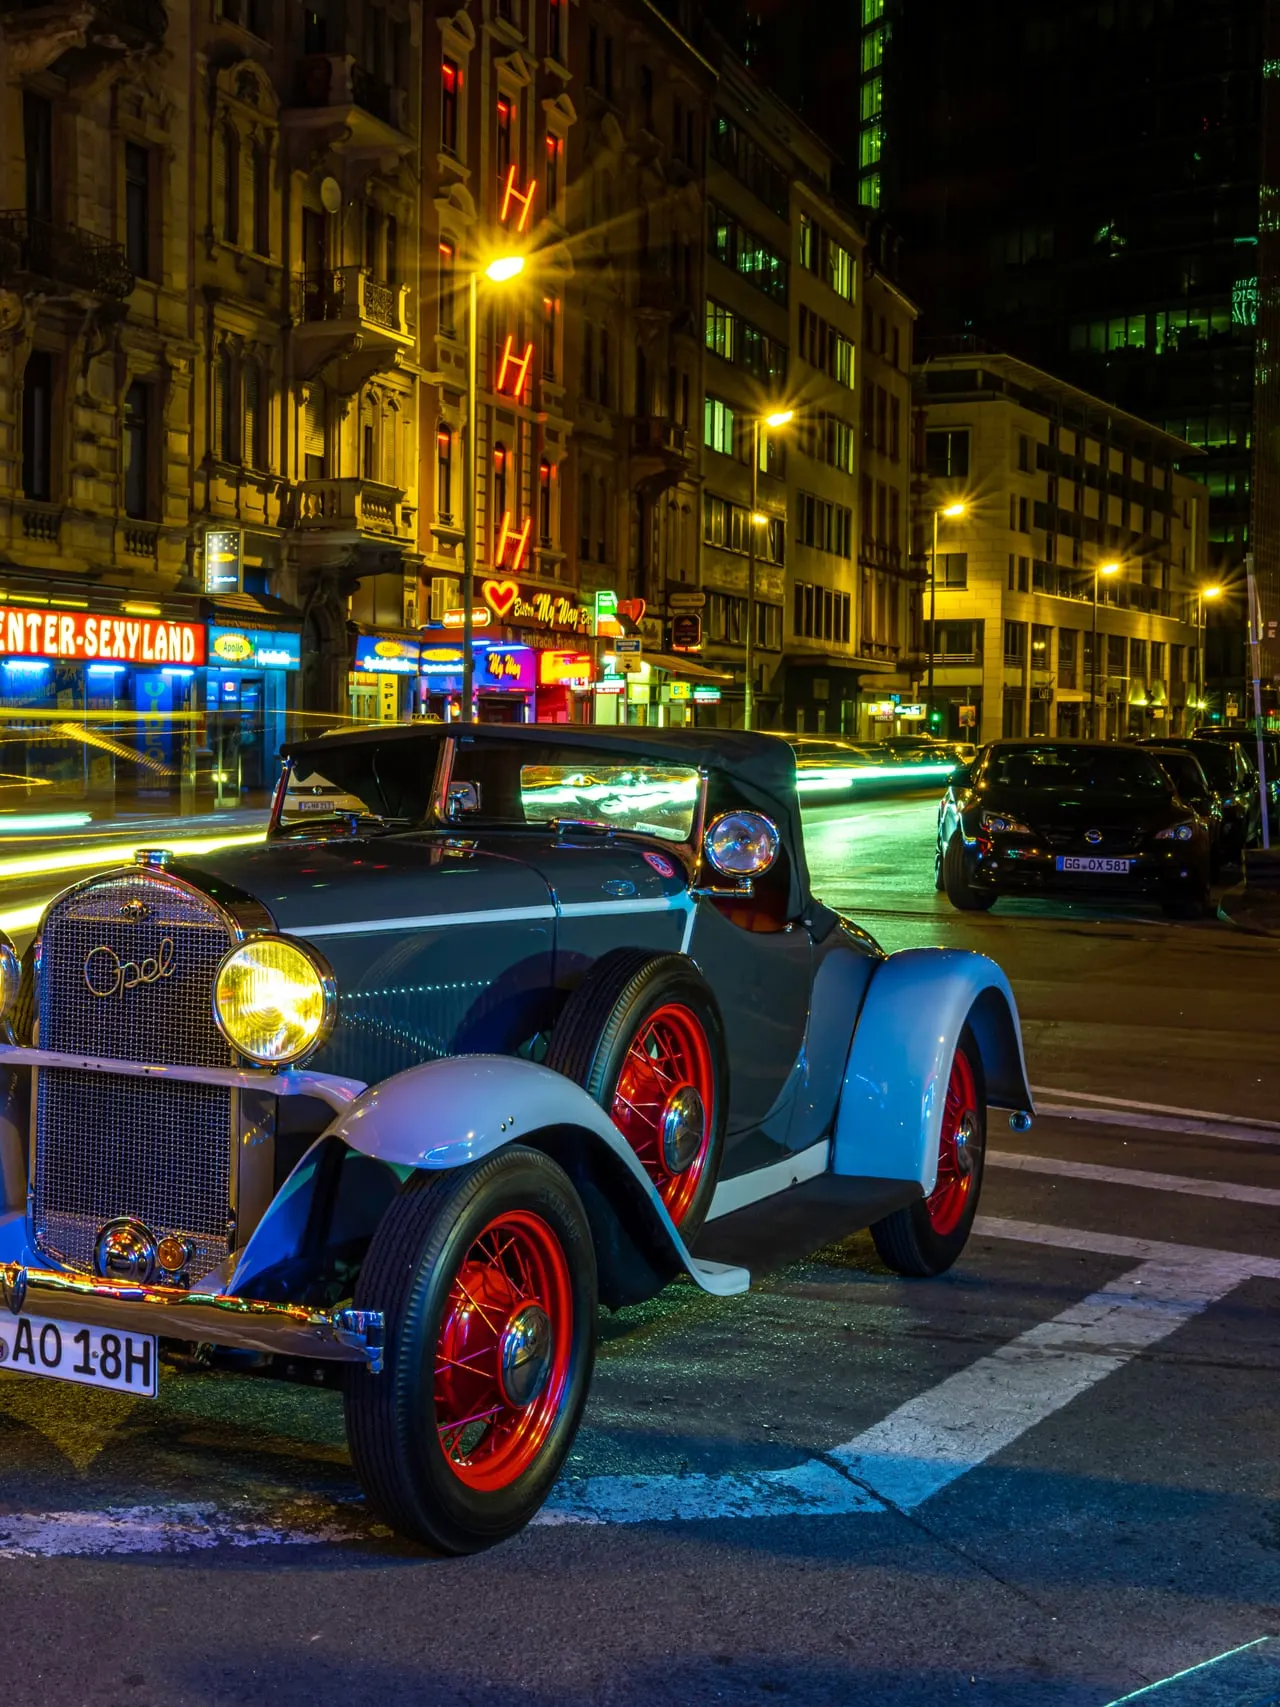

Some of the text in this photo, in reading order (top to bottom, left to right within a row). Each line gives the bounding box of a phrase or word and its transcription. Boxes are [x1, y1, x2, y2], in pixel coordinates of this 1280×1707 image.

[500, 165, 536, 232] H
[496, 335, 533, 396] H
[495, 510, 531, 571] H
[536, 593, 555, 628] My
[558, 597, 579, 630] Way
[223, 641, 244, 654] Apollo
[489, 652, 520, 680] My Way
[1064, 859, 1128, 872] GG OX 581
[84, 938, 176, 999] Opel
[12, 1317, 62, 1368] AO
[73, 1329, 151, 1387] 18H
